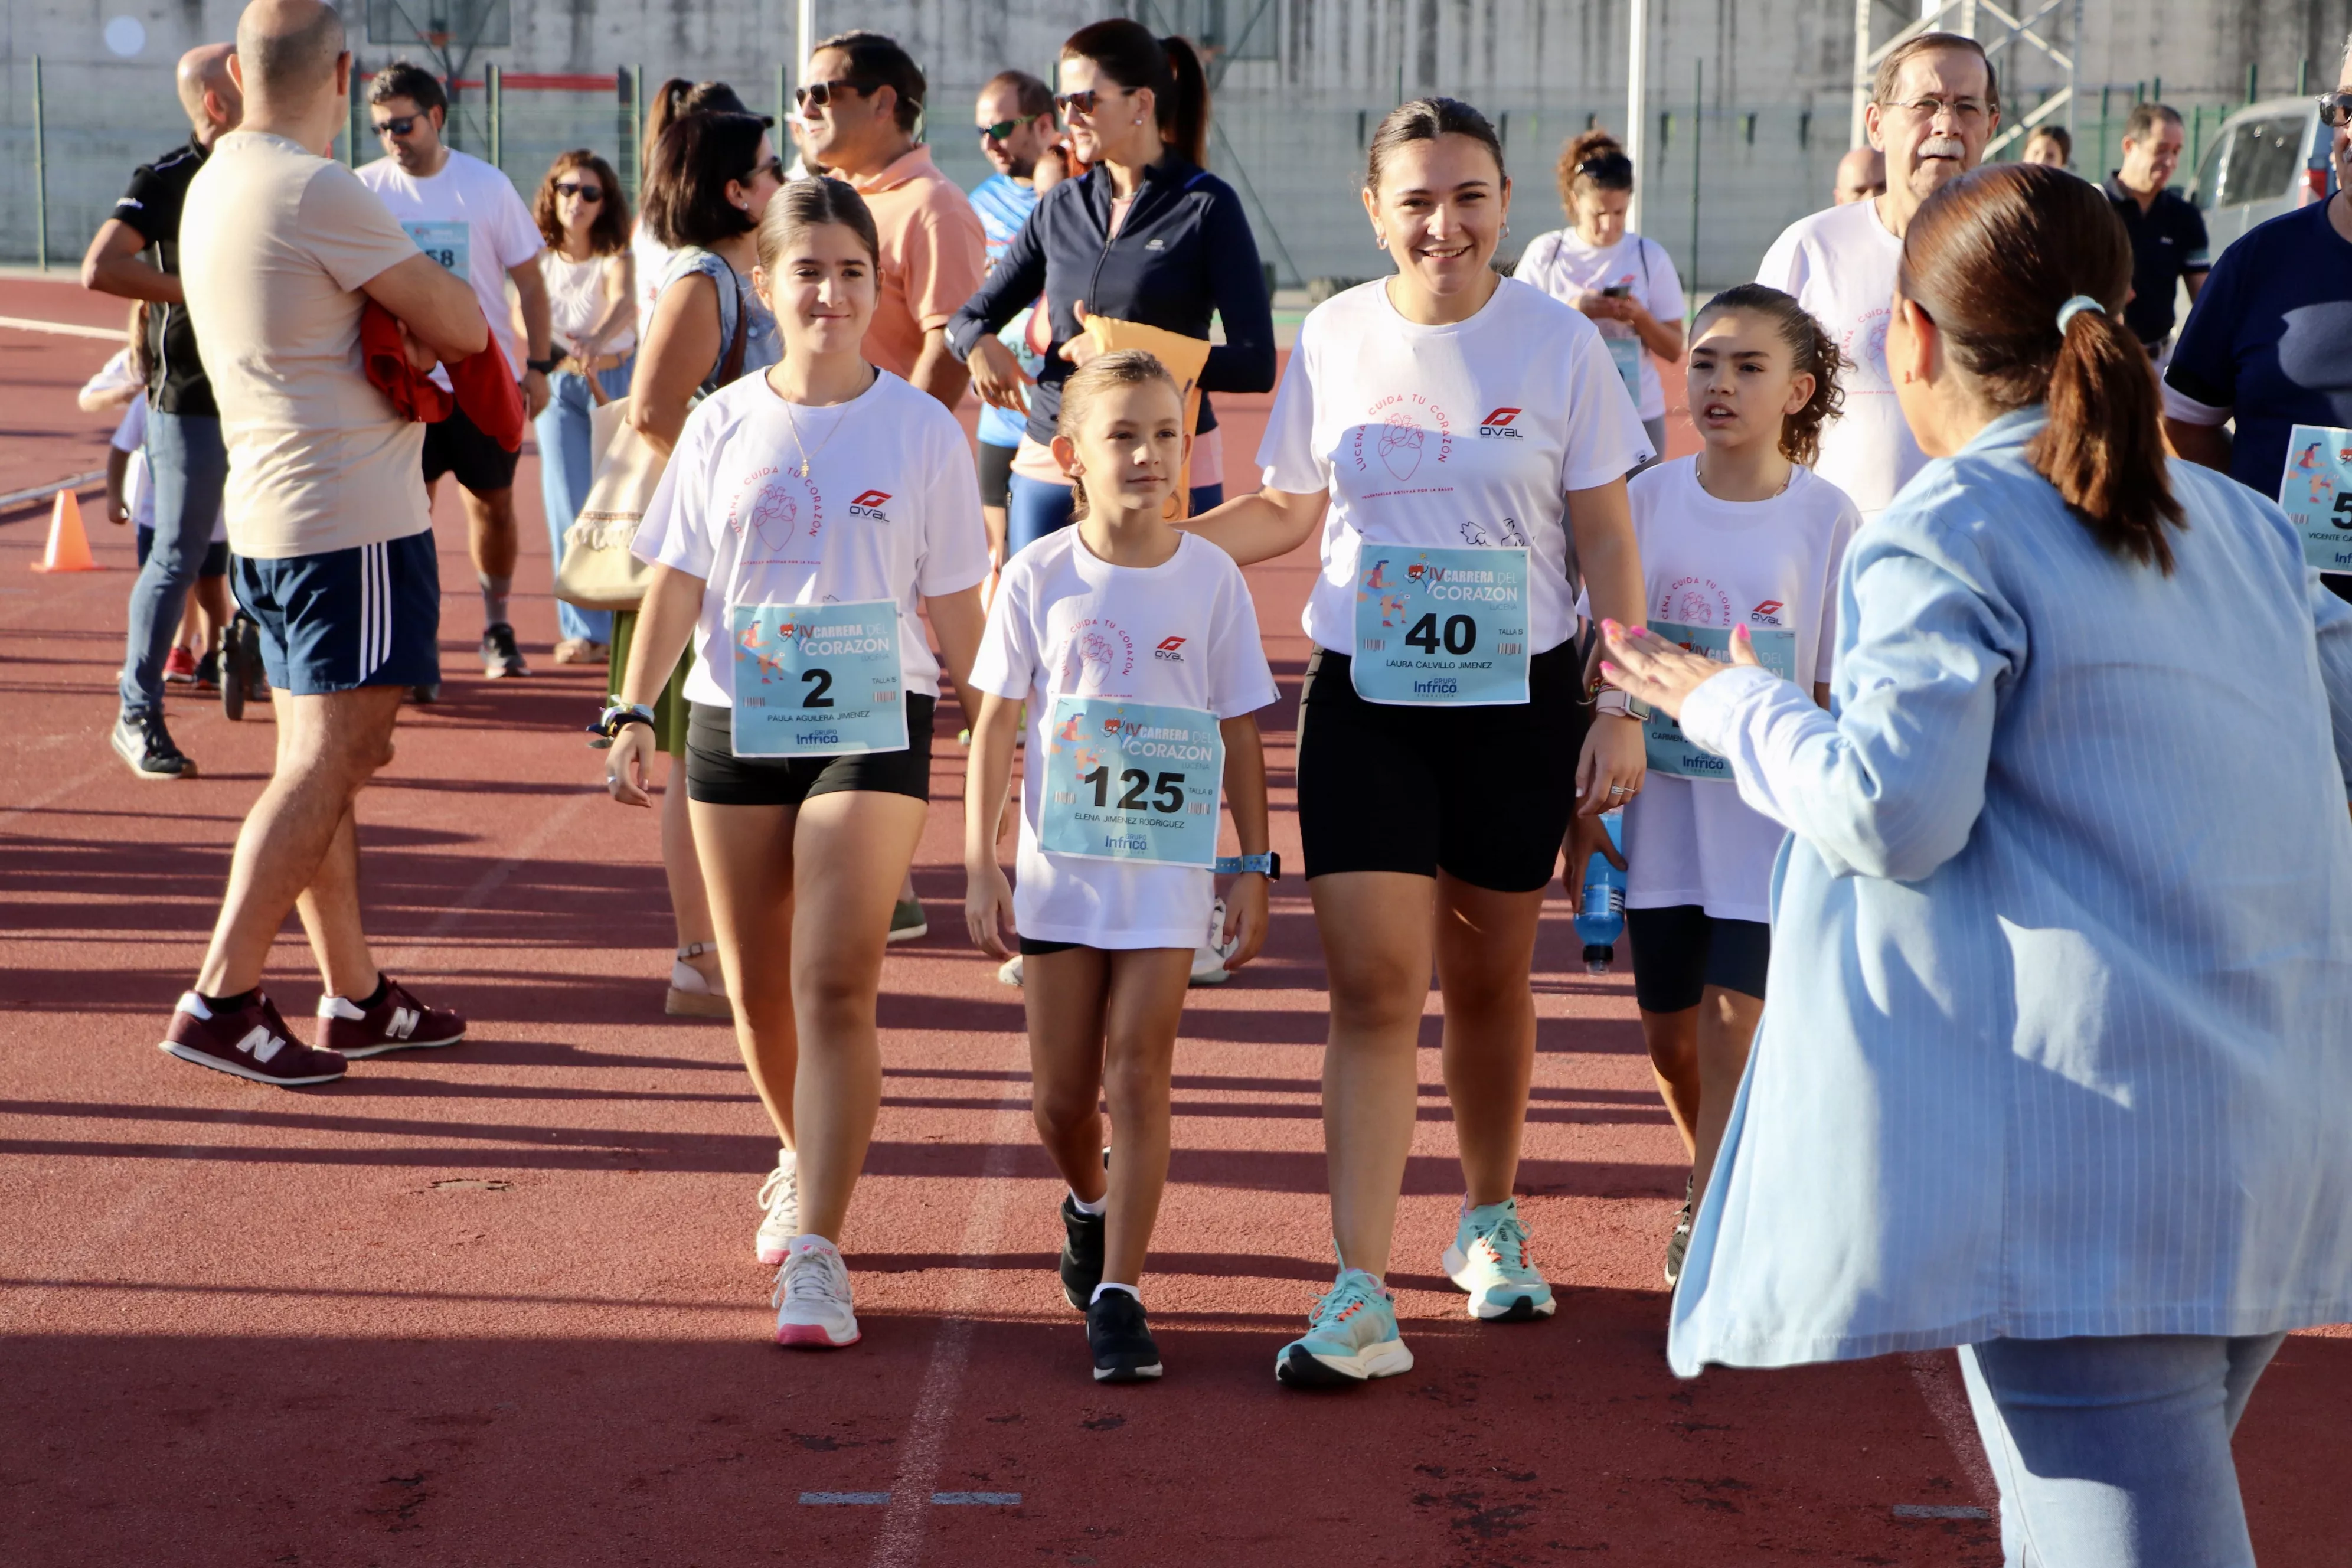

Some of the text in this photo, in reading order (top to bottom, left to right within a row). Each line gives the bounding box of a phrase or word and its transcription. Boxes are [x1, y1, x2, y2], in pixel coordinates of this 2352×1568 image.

[1858, 308, 1892, 323] CUIDA
[1368, 394, 1403, 415] CUIDA
[1412, 394, 1426, 404] TU
[1430, 404, 1452, 463] CORAZÓN
[744, 466, 779, 485] CUIDA
[788, 467, 801, 478] TU
[805, 479, 822, 537] CORAZÓN
[2309, 532, 2340, 541] VICENTE
[1429, 567, 1517, 583] IV CARRERA DEL
[1662, 595, 1671, 619] CENA
[1672, 577, 1700, 590] CUIDA
[1705, 579, 1717, 589] TU
[1718, 590, 1730, 626] CORAZ
[799, 623, 888, 638] IV CARRERA DEL
[1070, 619, 1097, 633] CUIDA
[1105, 619, 1116, 628] TU
[1405, 613, 1476, 655] 40
[1386, 659, 1413, 668] LAURA
[1762, 652, 1783, 664] DEL
[801, 668, 834, 708] 2
[1414, 681, 1457, 693] Infrico
[837, 710, 870, 720] JIMENEZ
[796, 733, 838, 744] Infrico
[1126, 723, 1213, 743] IV CARRERA DEL
[1652, 732, 1683, 742] CARMEN
[1683, 756, 1724, 769] Infrico
[1084, 766, 1185, 813] 125
[1188, 787, 1207, 795] TALLA
[1074, 812, 1185, 828] ELENA JIMENEZ RODRIGUEZ
[1105, 835, 1147, 850] Infrico
[385, 1007, 420, 1040] N
[236, 1024, 286, 1063] N
